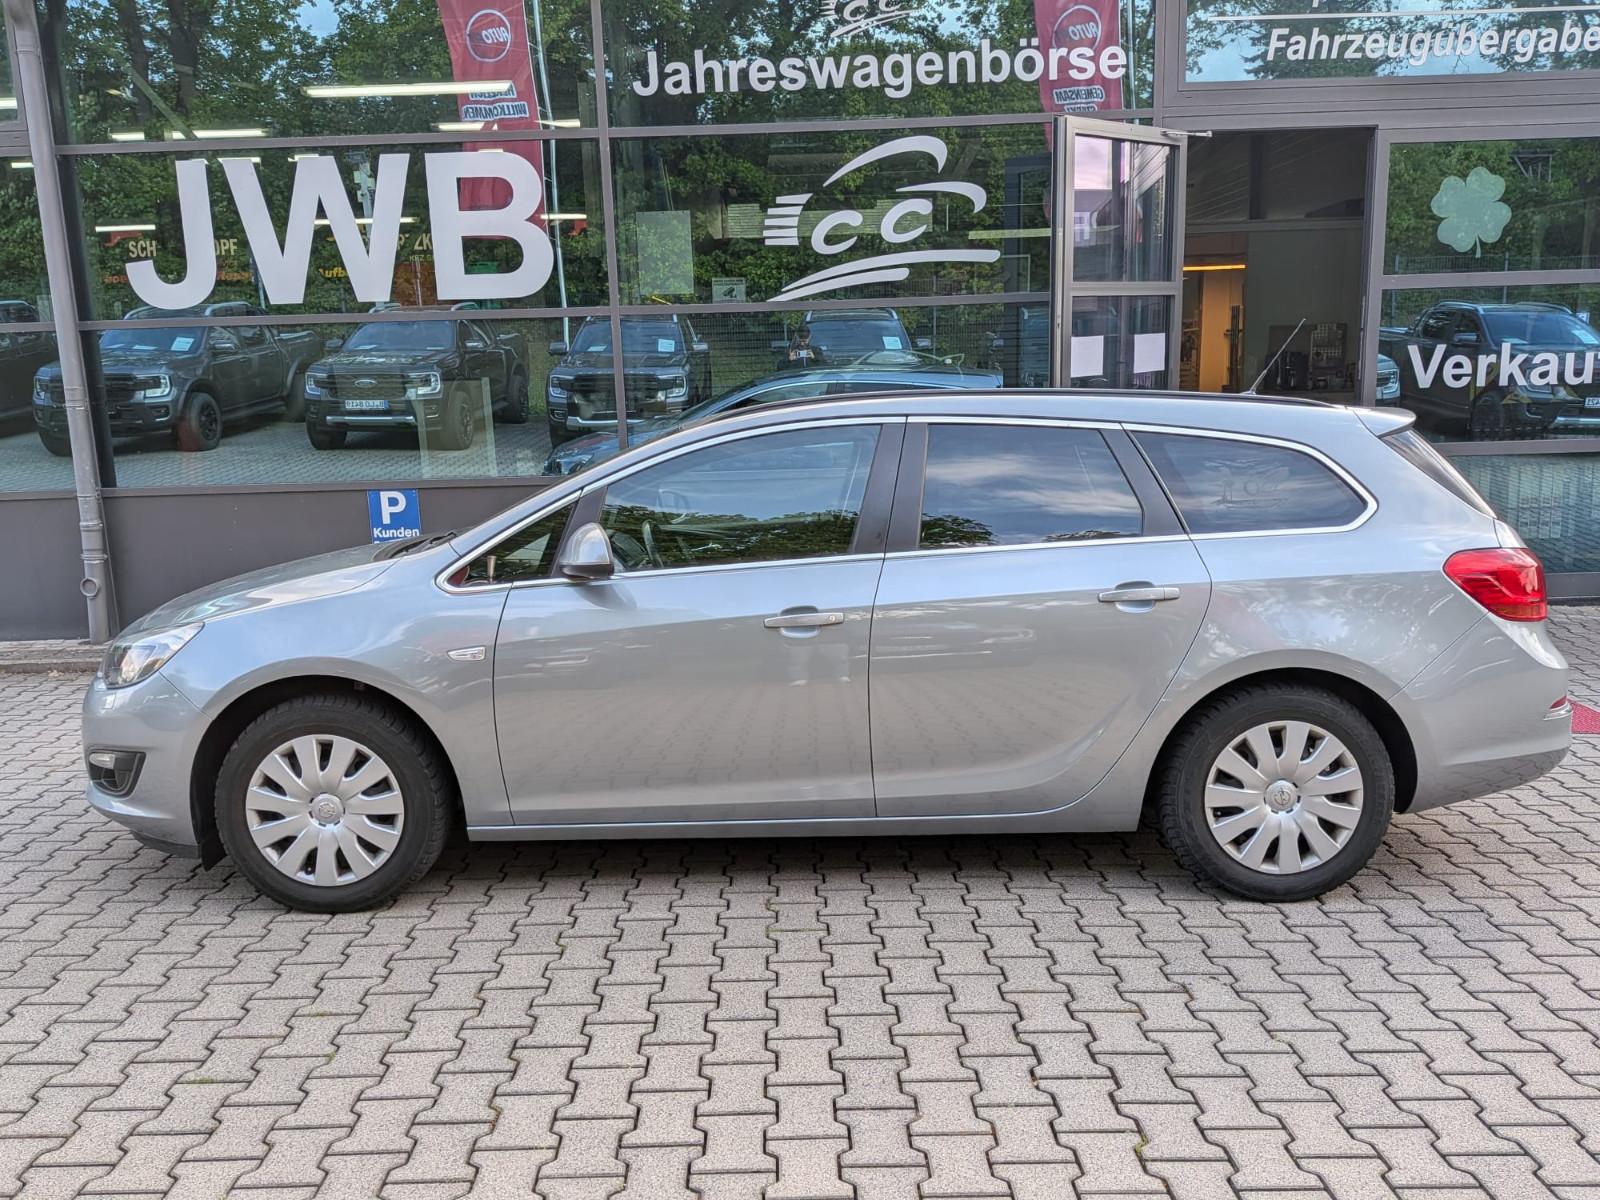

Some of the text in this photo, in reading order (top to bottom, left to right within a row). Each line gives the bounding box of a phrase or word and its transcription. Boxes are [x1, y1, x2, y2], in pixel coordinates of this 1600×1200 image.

[1266, 20, 1600, 67] Fahrzeugübergabe
[632, 38, 1128, 99] Jahreswagenbörse
[125, 151, 555, 311] JWB
[1407, 342, 1600, 389] Verkau
[380, 491, 406, 524] P
[373, 526, 420, 538] Kunden
